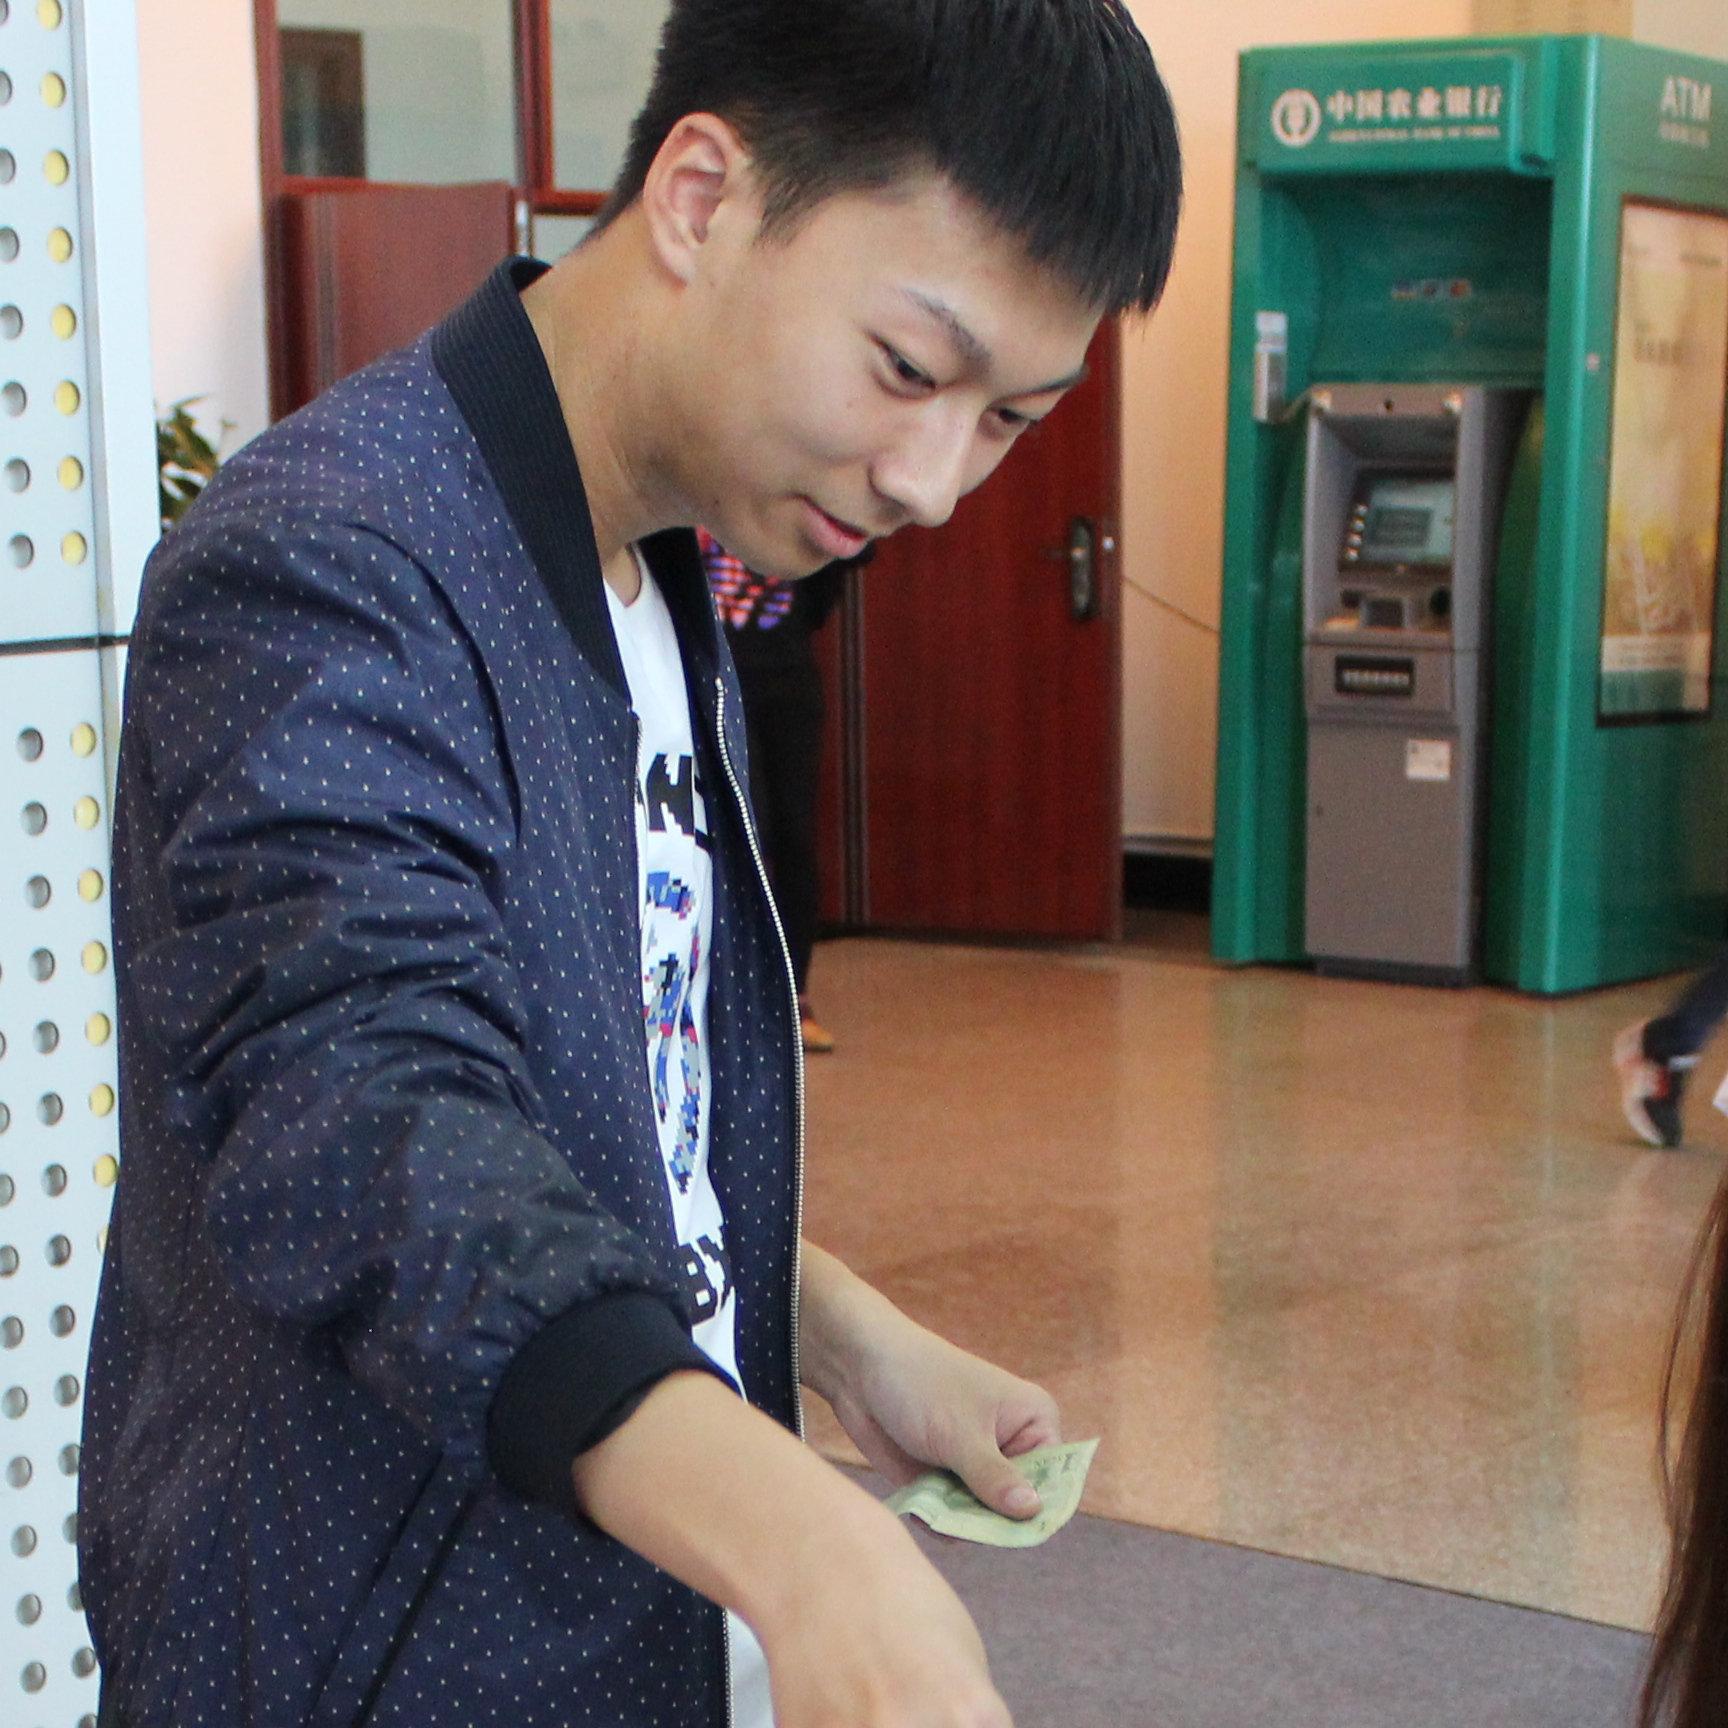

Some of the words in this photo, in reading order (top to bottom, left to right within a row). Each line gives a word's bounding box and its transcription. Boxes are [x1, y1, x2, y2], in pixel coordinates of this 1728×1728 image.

[1327, 85, 1501, 122] 中国农业银行
[1660, 76, 1712, 121] ATM
